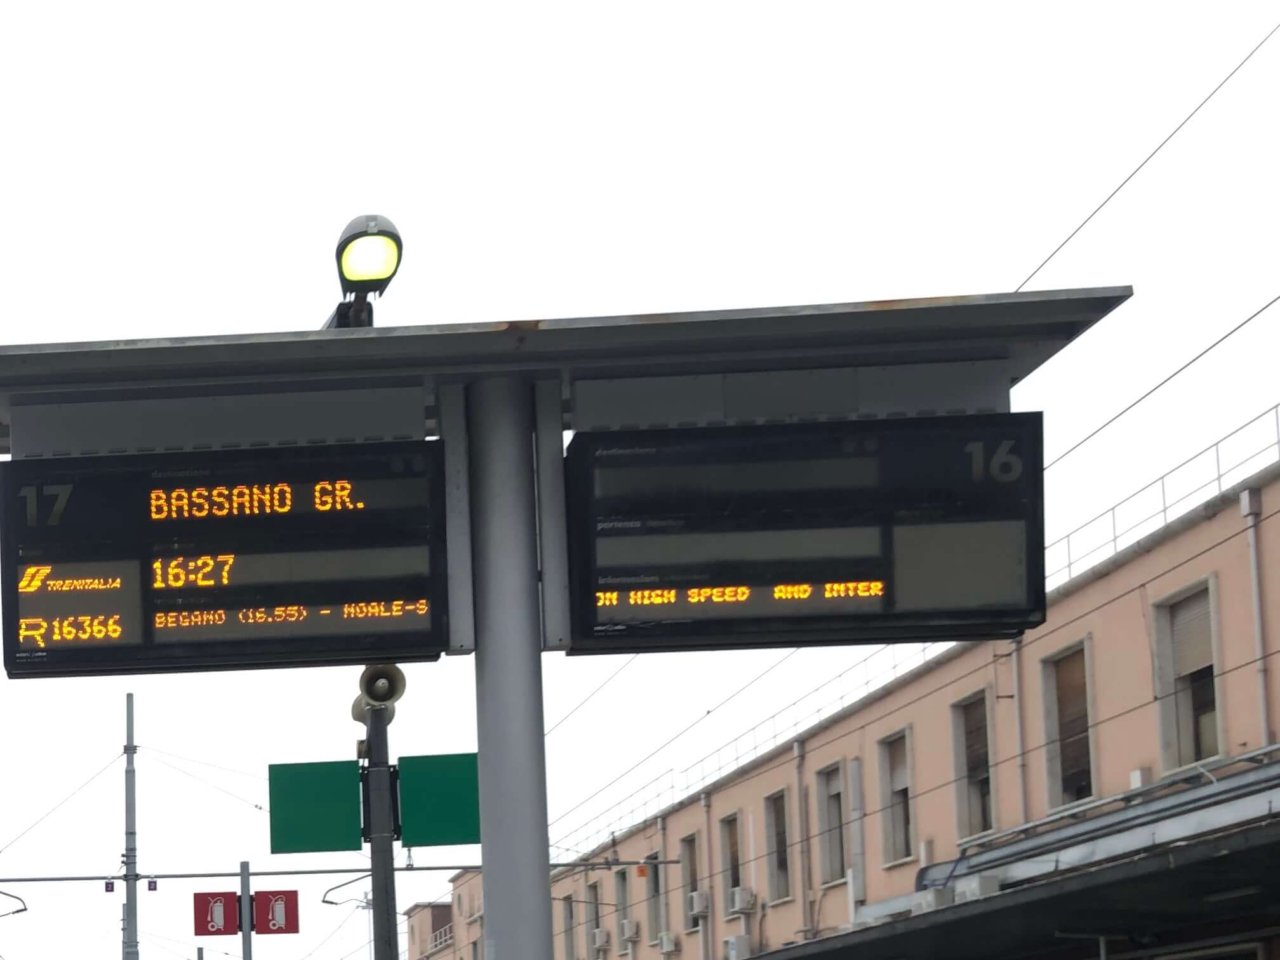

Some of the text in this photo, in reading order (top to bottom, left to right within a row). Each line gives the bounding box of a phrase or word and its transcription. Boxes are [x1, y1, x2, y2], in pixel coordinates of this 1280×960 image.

[964, 440, 1023, 483] 16
[18, 484, 73, 527] 17
[150, 480, 365, 520] BASSANO GR.
[46, 577, 122, 591] TRENITALIA
[152, 554, 235, 589] 16:27
[629, 589, 676, 605] HIGH
[687, 586, 751, 603] SPEED
[773, 584, 813, 600] AND
[824, 581, 884, 598] INTER
[238, 605, 308, 623] (16.55)
[19, 615, 122, 648] R 16366
